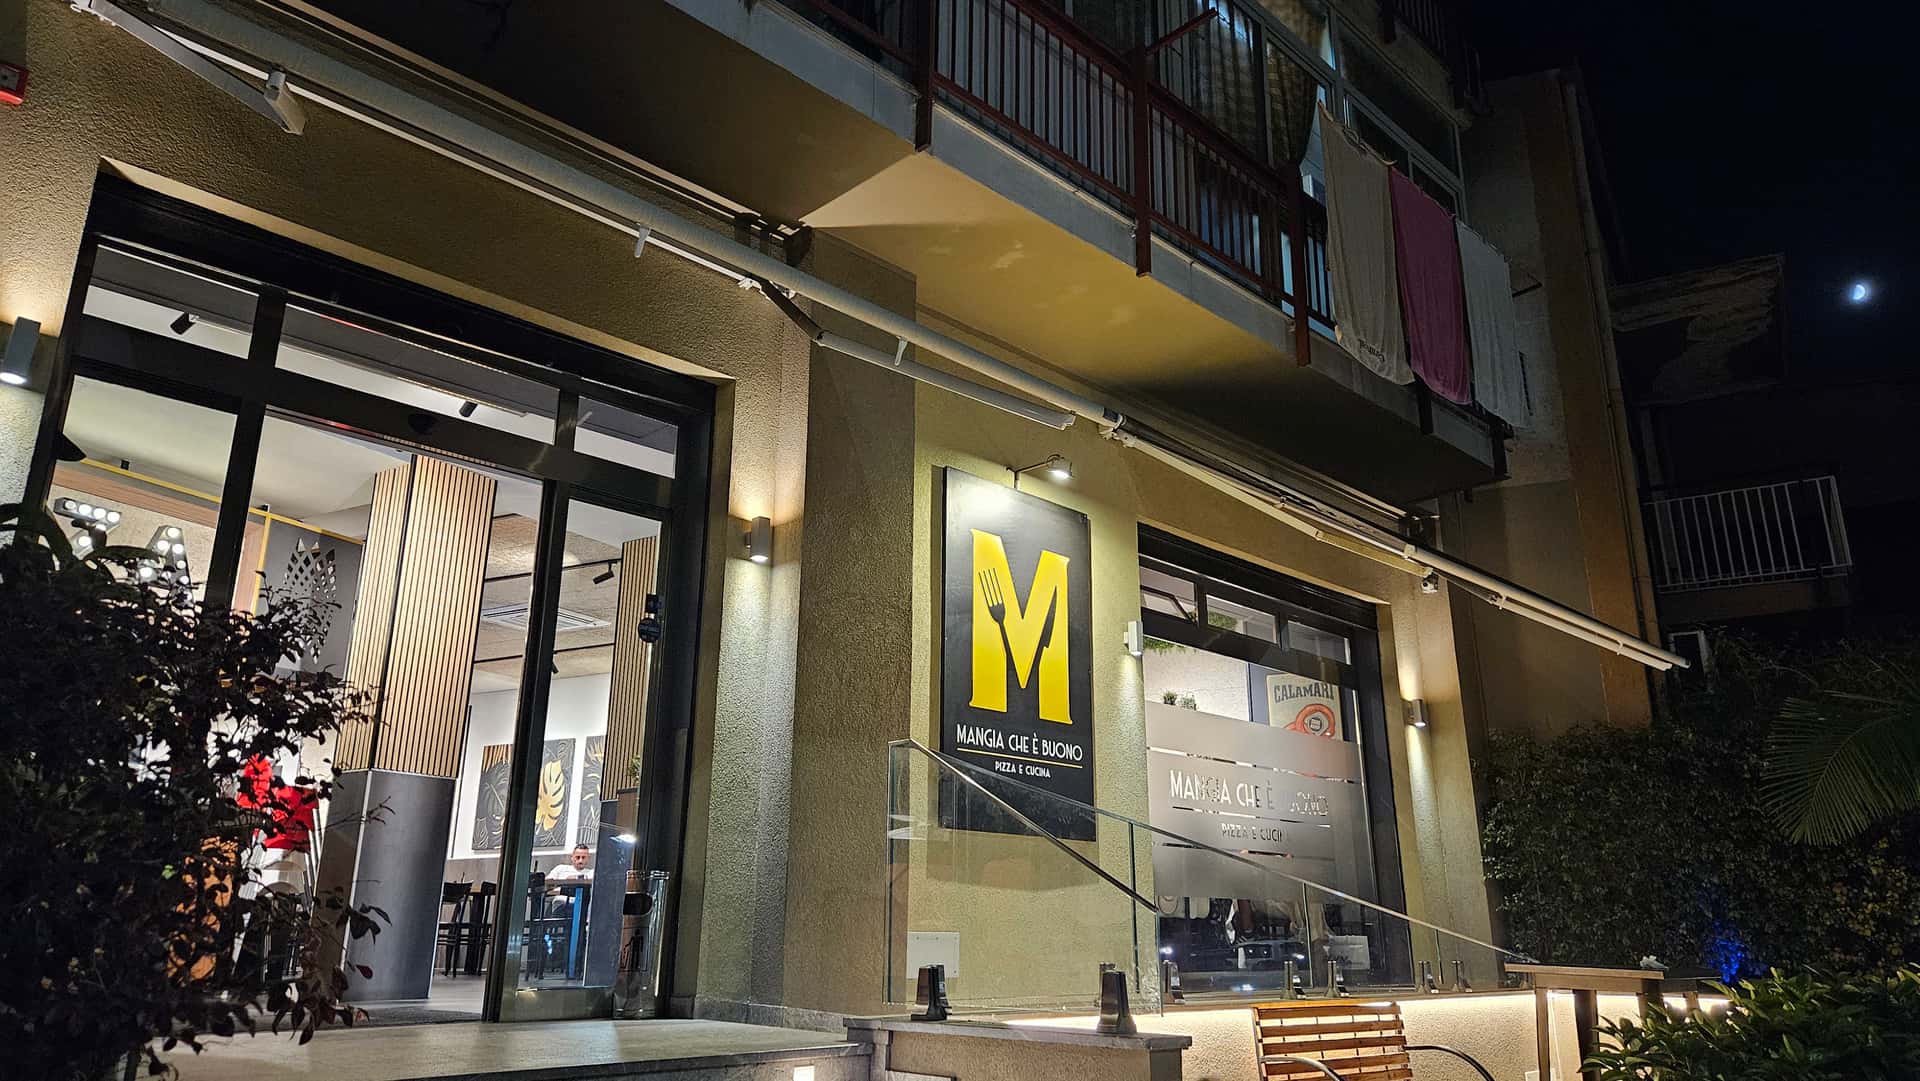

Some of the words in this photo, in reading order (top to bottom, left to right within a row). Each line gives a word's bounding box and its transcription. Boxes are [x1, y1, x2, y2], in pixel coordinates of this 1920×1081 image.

[1273, 682, 1335, 703] CALAMARI
[956, 723, 1005, 750] MANGIA
[1008, 734, 1029, 753] CHE
[1032, 732, 1039, 755] È
[1041, 739, 1083, 761] BUONO
[995, 760, 1017, 774] PIZZA
[1018, 766, 1023, 775] E
[1025, 766, 1051, 778] CUCINA
[1169, 769, 1232, 804] MANGIA
[1236, 783, 1260, 808] CHE
[1221, 822, 1248, 838] PIZZA
[1259, 828, 1284, 843] CUCI
